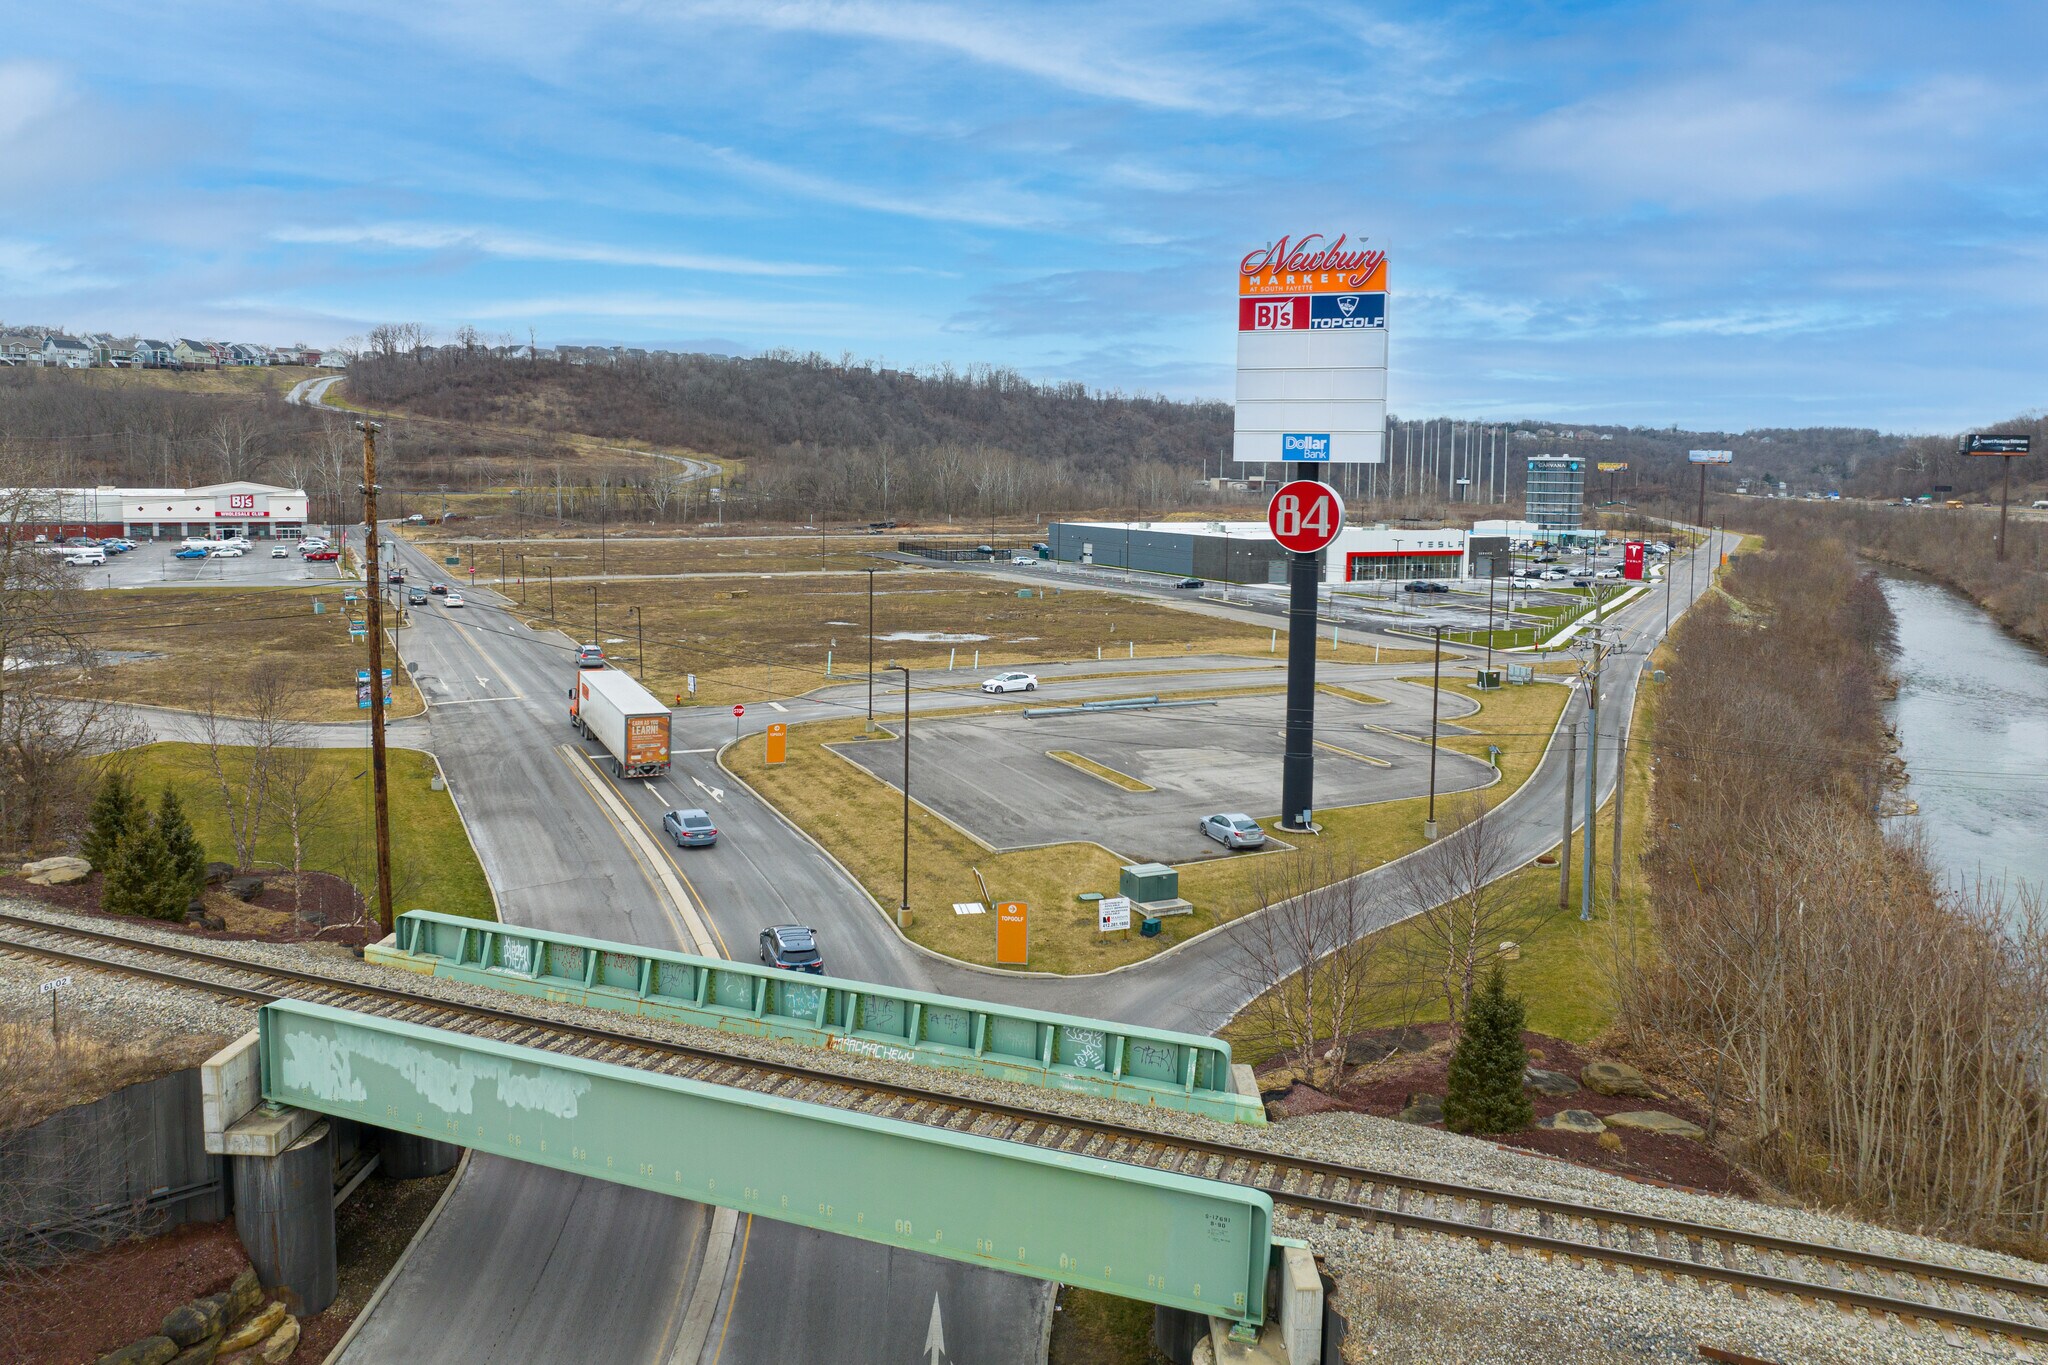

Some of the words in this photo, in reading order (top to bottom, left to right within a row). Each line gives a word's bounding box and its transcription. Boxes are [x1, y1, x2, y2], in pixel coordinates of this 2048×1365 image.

[1240, 233, 1385, 287] Newbury
[1249, 273, 1347, 286] MARKET
[1312, 317, 1384, 328] TOPGOLF
[1286, 436, 1328, 450] Dollar
[1304, 449, 1327, 459] Bank
[1276, 494, 1331, 537] 84
[632, 725, 659, 735] LEARN!
